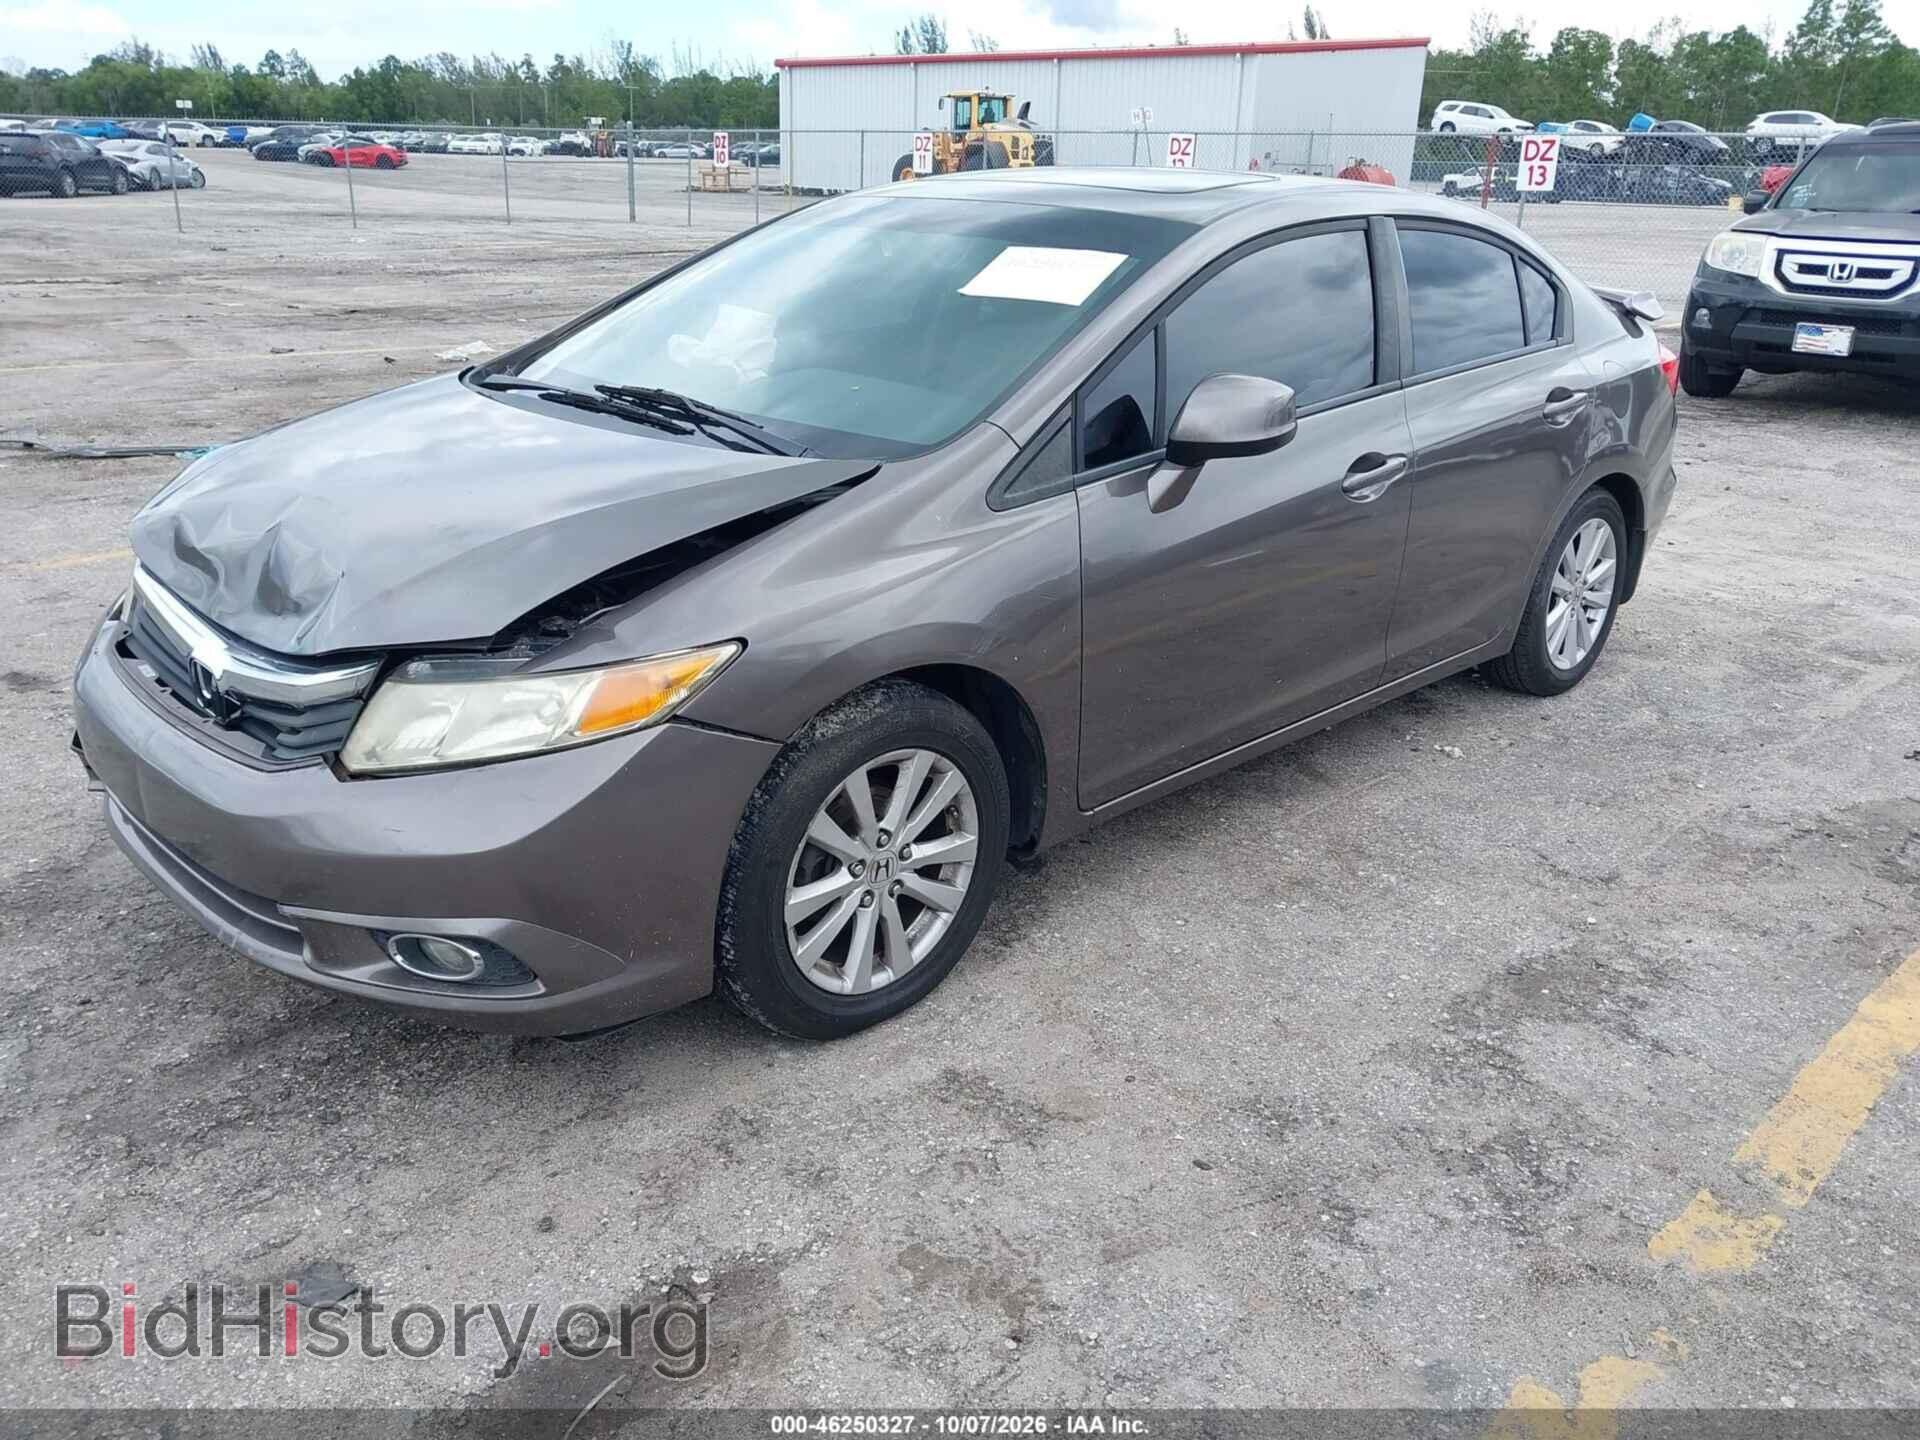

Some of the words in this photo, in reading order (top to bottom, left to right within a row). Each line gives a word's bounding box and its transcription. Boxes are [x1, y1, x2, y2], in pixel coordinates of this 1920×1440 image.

[715, 135, 726, 148] DZ
[915, 136, 931, 152] DZ
[1169, 137, 1193, 156] DZ
[716, 151, 726, 164] 10
[1523, 139, 1557, 162] DZ
[919, 154, 926, 169] 11
[1527, 165, 1547, 186] 13
